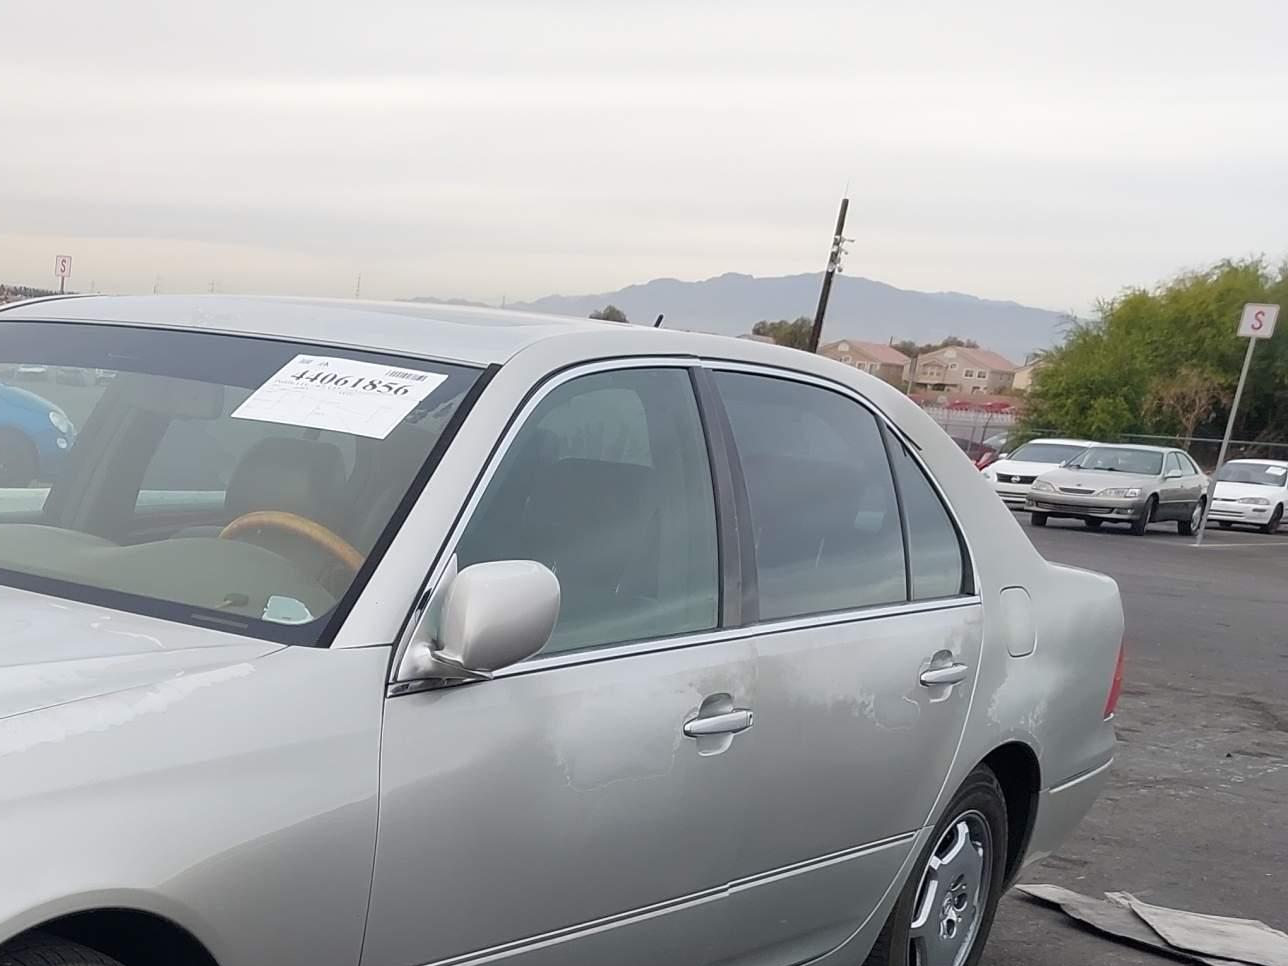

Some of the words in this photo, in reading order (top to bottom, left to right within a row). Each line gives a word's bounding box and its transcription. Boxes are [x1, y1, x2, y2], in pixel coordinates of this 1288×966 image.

[60, 258, 67, 273] S
[1251, 310, 1265, 331] S
[290, 369, 410, 396] 44061856
